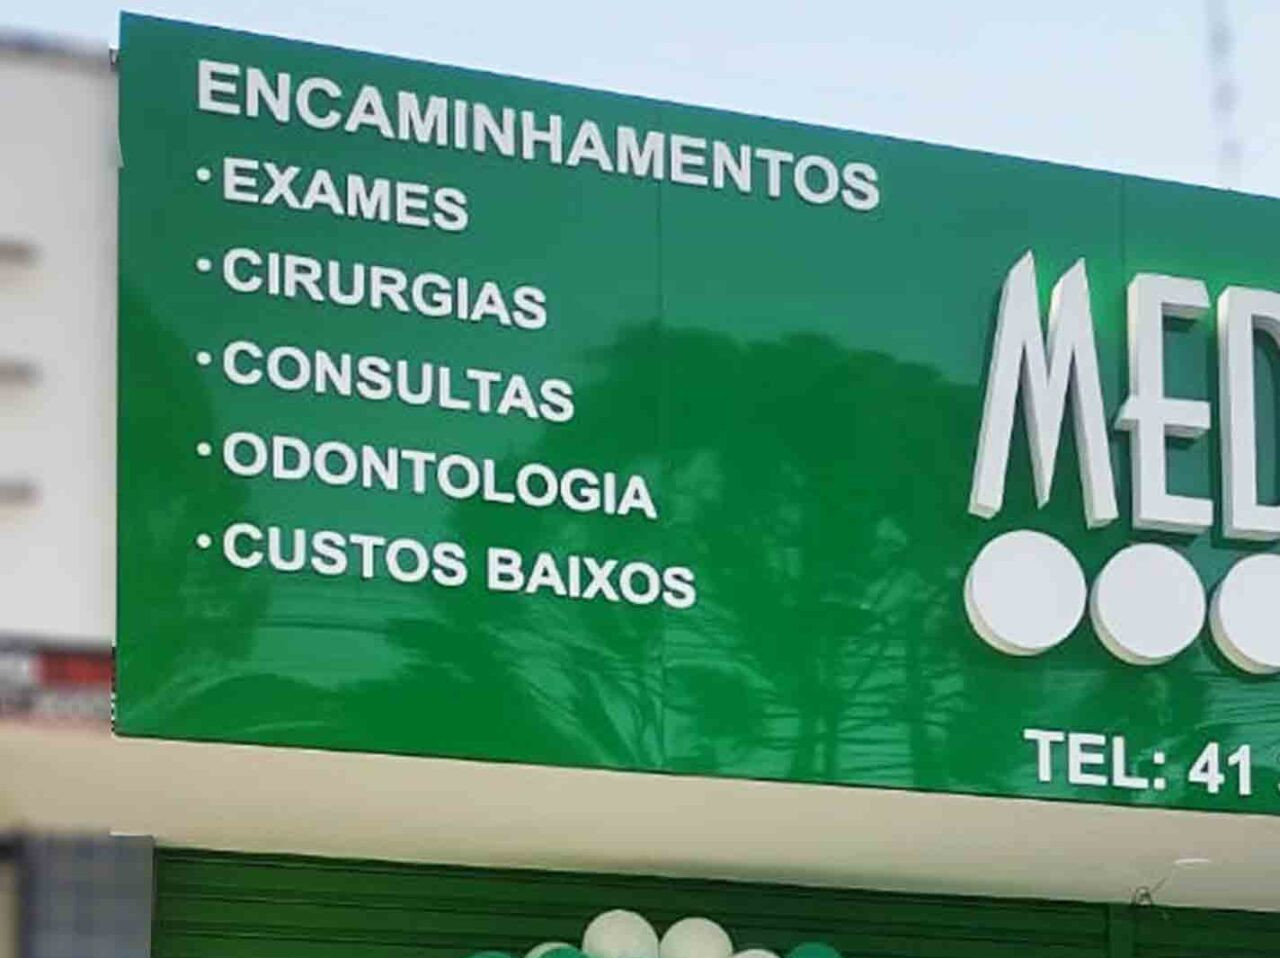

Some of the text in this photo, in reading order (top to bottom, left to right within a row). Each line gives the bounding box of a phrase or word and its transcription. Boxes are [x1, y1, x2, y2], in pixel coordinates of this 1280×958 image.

[198, 60, 881, 211] ENCAMINHAMENTOS
[223, 157, 469, 232] EXAMES
[222, 248, 548, 330] CIRURGIAS
[222, 341, 575, 422] CONSULTAS
[222, 432, 658, 519] ODONTOLOGIA
[222, 523, 697, 609] CUSTOS BAIXOS
[1024, 729, 1166, 790] TEL:
[1189, 742, 1252, 796] 41
